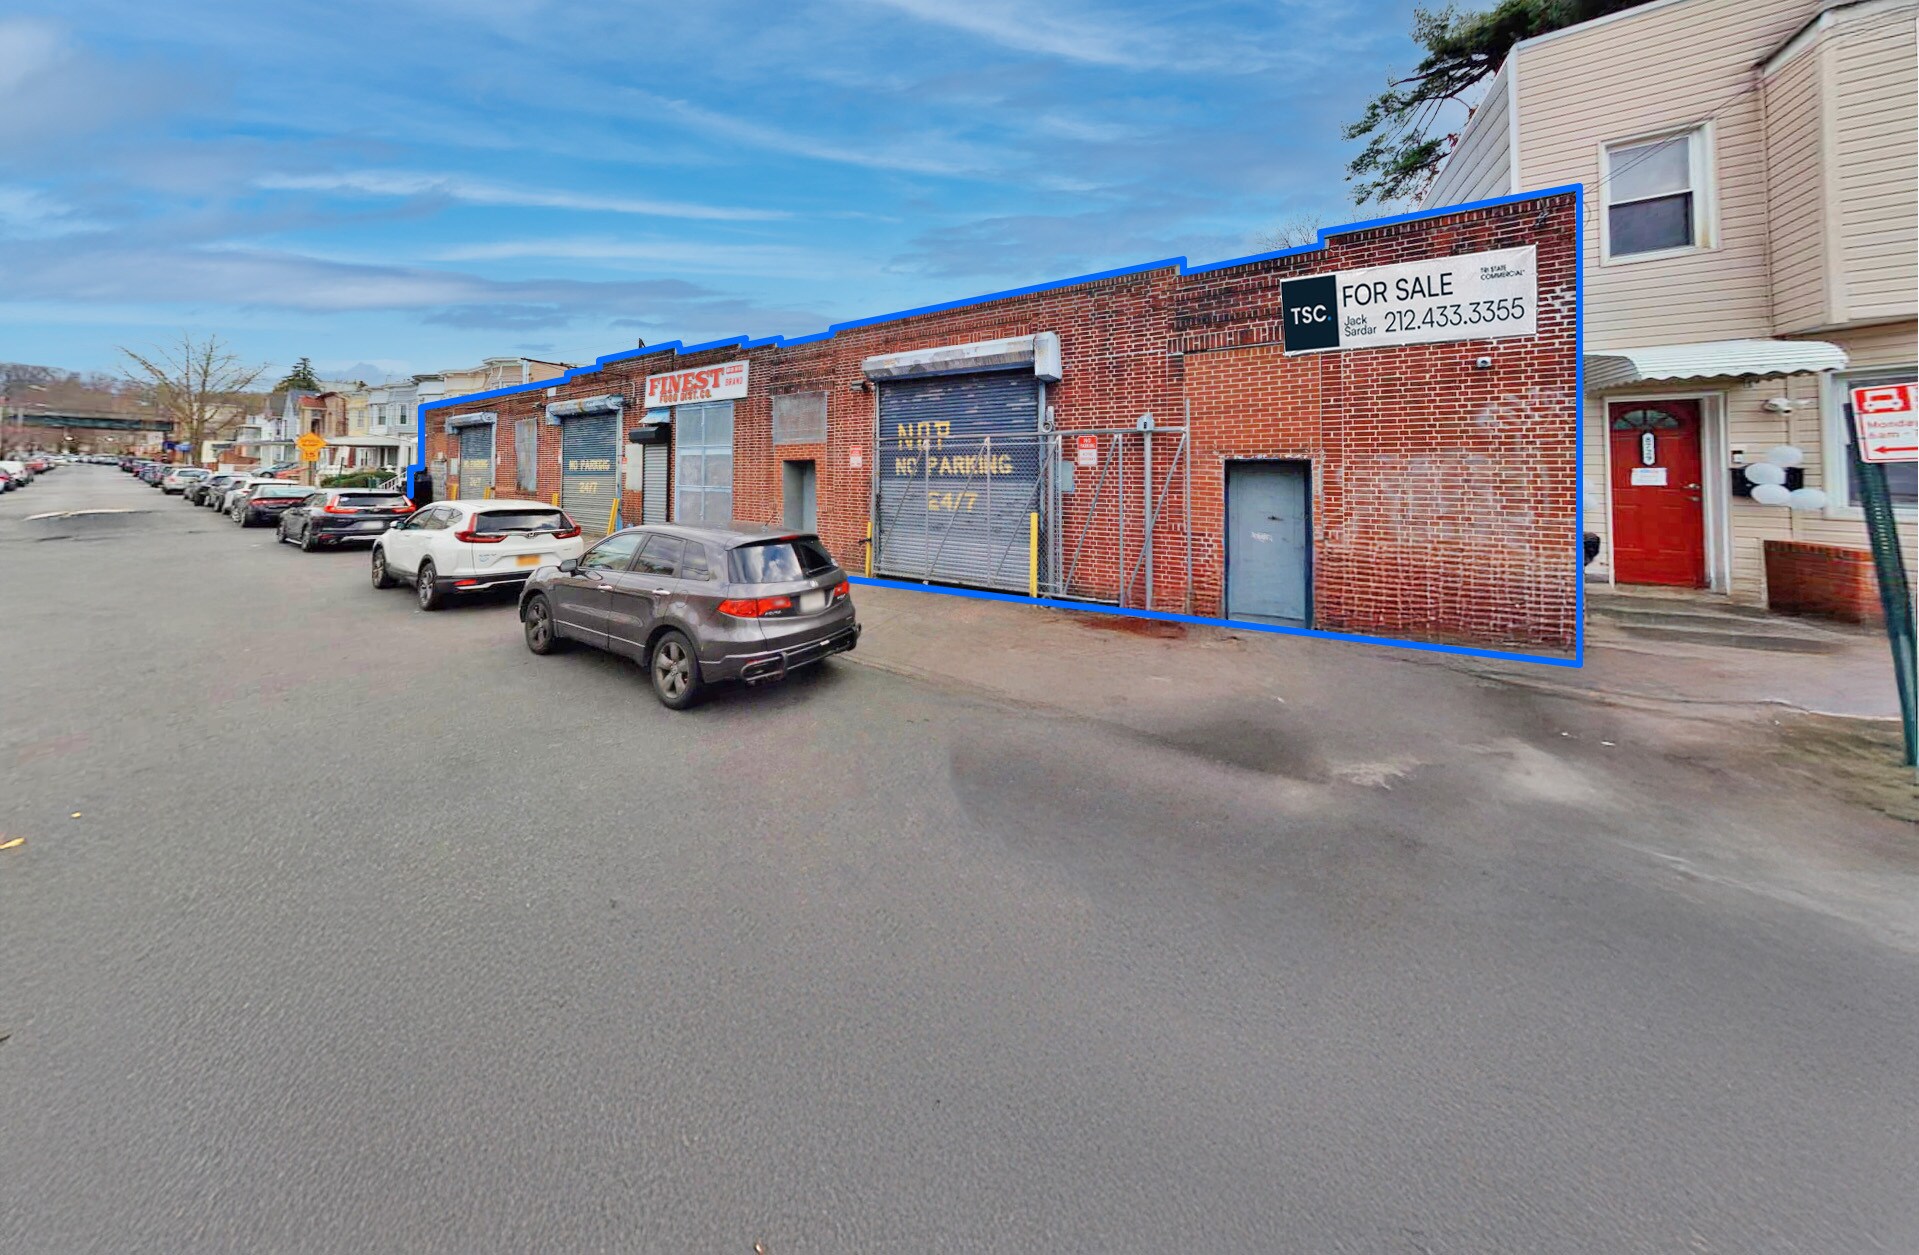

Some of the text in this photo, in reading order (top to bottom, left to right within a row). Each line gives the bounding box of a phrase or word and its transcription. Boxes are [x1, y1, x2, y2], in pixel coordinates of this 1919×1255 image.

[1480, 270, 1523, 280] COMMERCIAL
[1342, 272, 1453, 308] FOR SALE
[1344, 314, 1367, 327] Jack
[1384, 297, 1525, 332] 212.433.3355
[1344, 325, 1377, 337] Sardar
[649, 367, 724, 396] FINEST
[895, 454, 1013, 476] NO PARKING
[927, 491, 978, 512] 24/7
